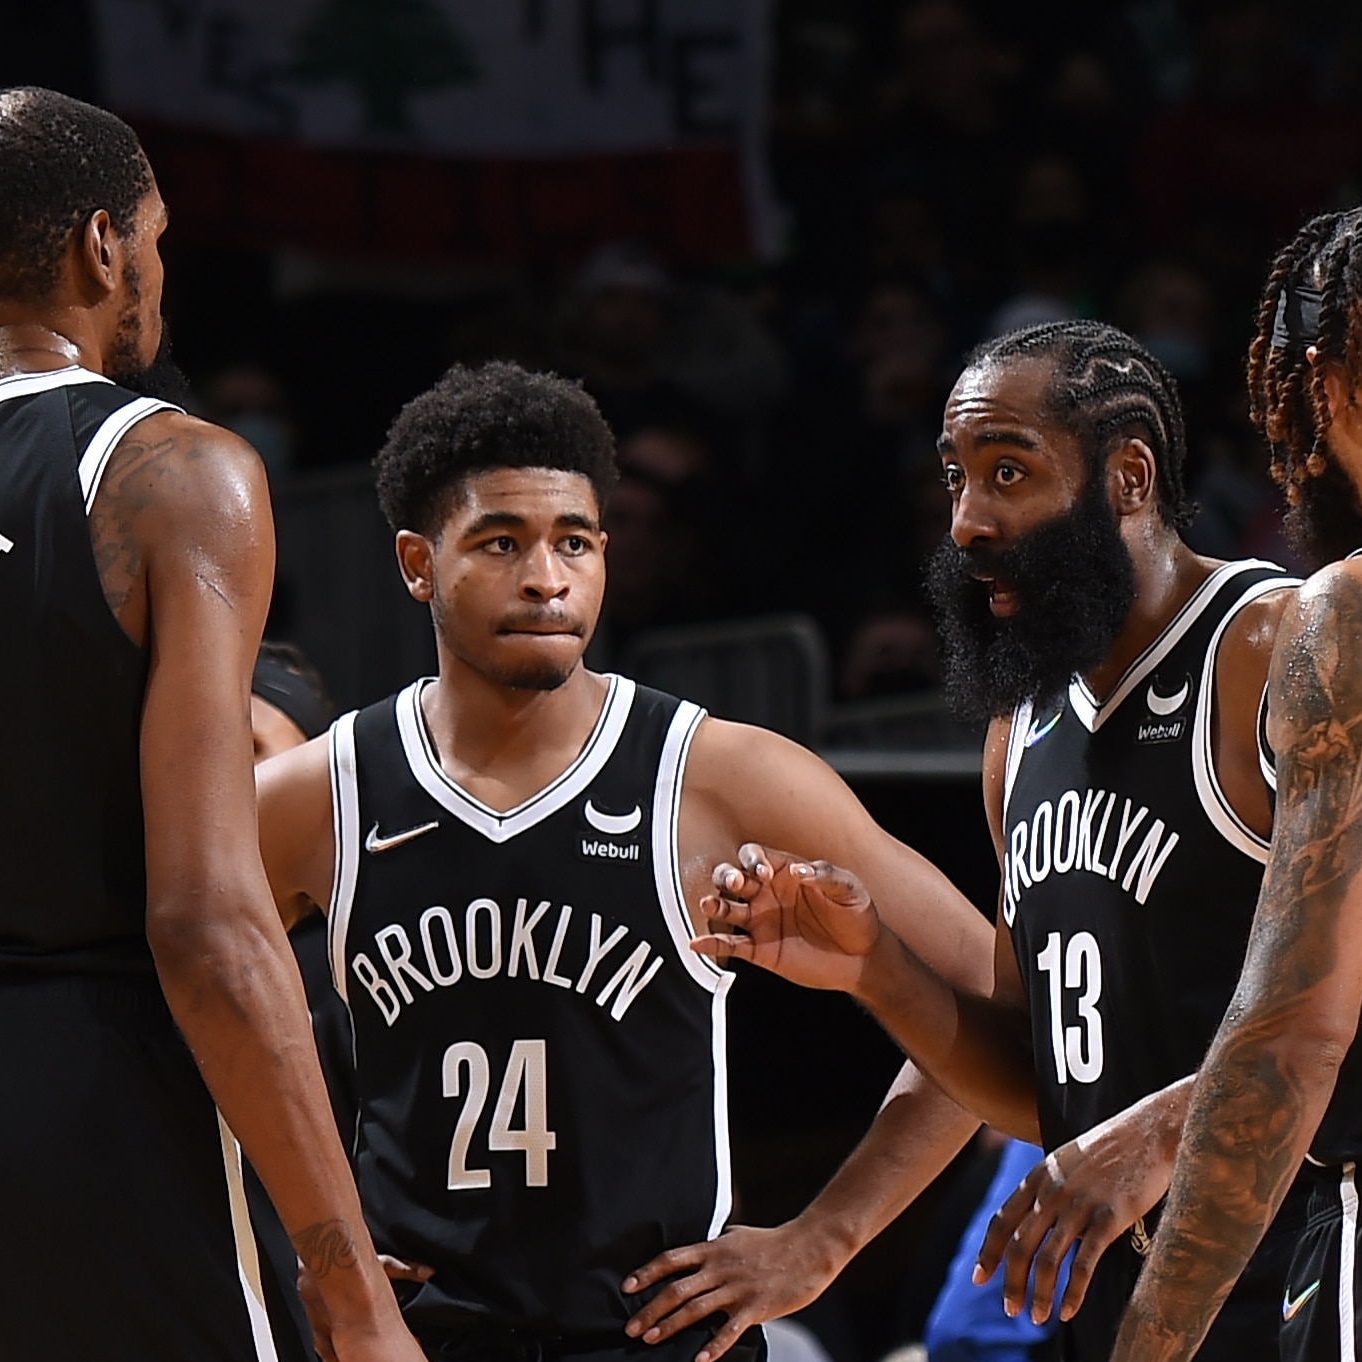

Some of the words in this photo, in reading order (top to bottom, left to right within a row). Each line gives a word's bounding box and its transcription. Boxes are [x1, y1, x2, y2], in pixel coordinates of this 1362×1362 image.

[1138, 721, 1181, 741] Webull
[580, 839, 641, 861] Webull
[352, 897, 665, 1028] BROOKLYN
[1036, 930, 1105, 1085] 13
[441, 1038, 557, 1191] 24
